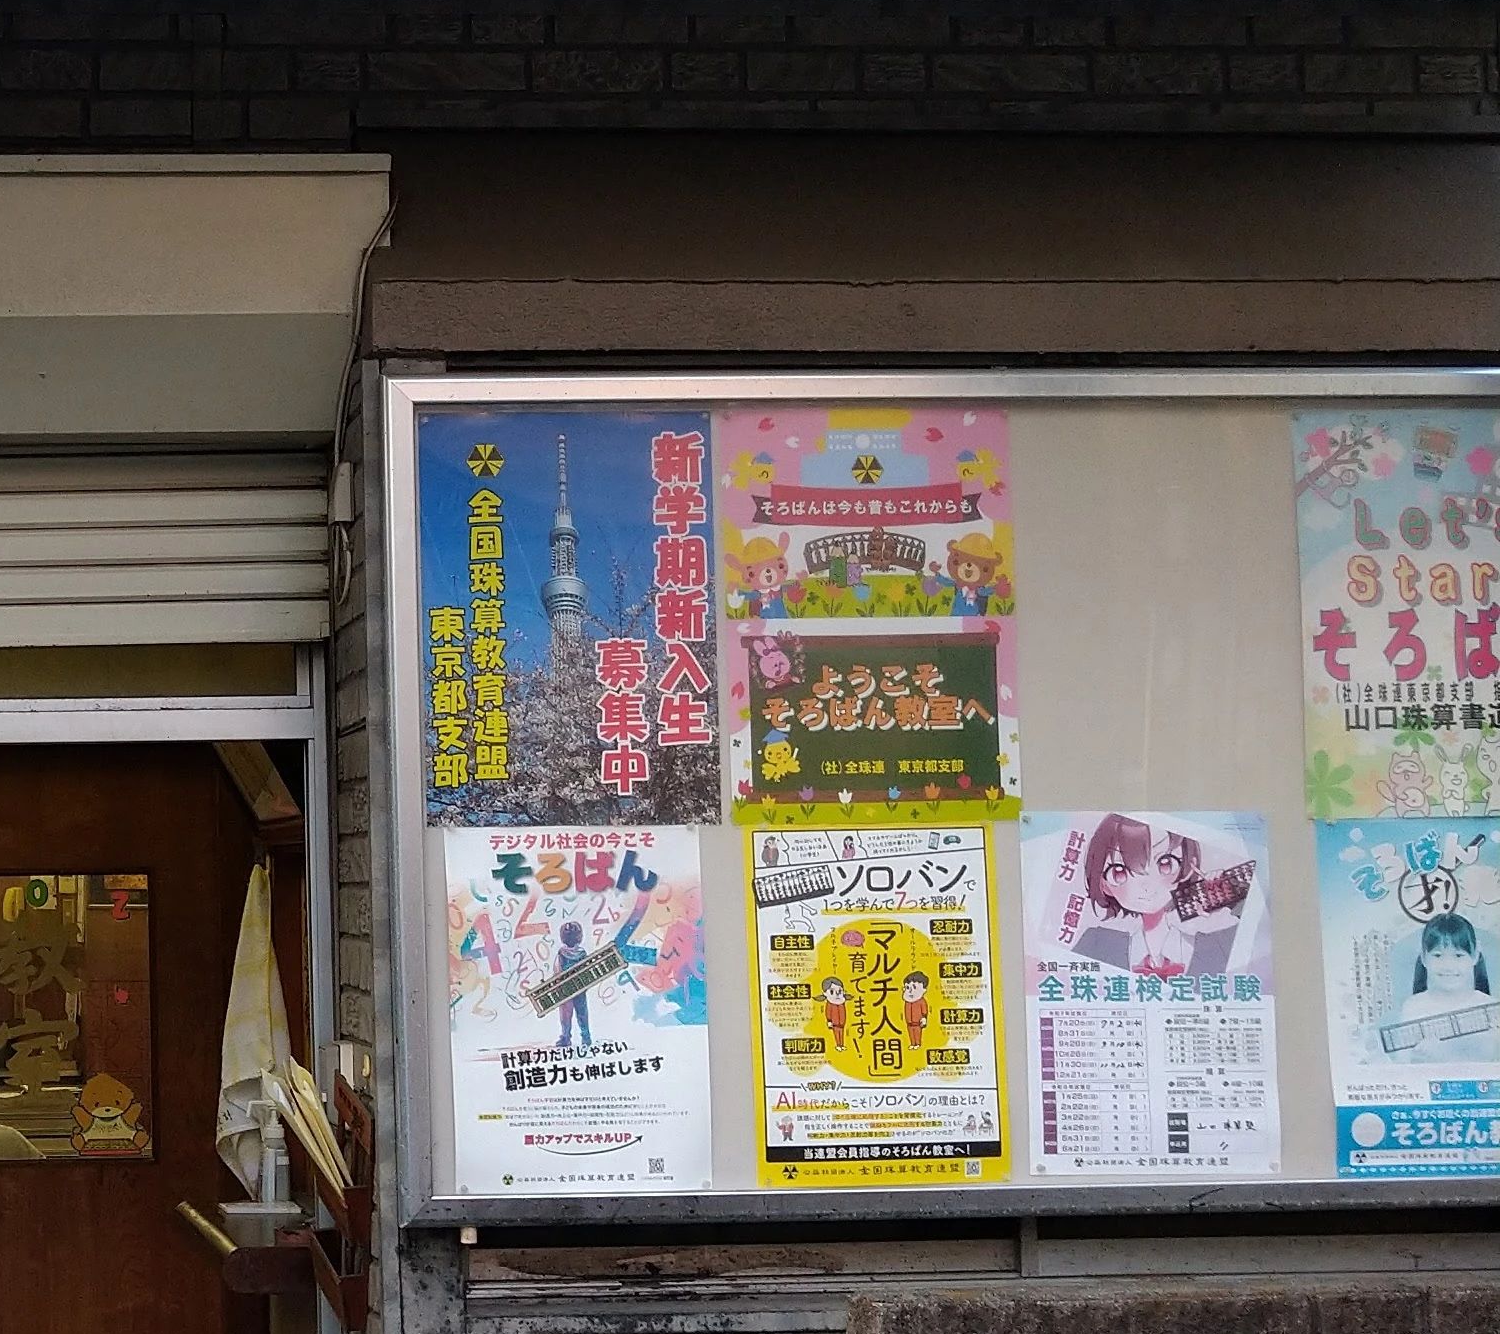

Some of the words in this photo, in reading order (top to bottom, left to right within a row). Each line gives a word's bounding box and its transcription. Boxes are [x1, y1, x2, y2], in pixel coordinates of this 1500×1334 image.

[761, 498, 972, 516] そろばんは今も昔もこれからも
[651, 430, 711, 746] 新学期新入生
[467, 488, 509, 781] 全国珠算教育連盟
[812, 662, 944, 698] ようこそ
[430, 606, 468, 787] 東京都支部
[595, 638, 649, 794] 募集中
[762, 695, 995, 731] そろばん教室へ
[489, 832, 655, 851] デジタル社会の今こそ
[1058, 830, 1086, 882] 計算力
[491, 850, 658, 894] そろばん
[933, 920, 971, 933] 忍耐力
[1058, 893, 1085, 944] 記憶力
[774, 936, 812, 949] 自主性
[942, 963, 979, 977] 集中力
[1037, 961, 1100, 973] 全国一斉実施
[770, 986, 809, 998] 社会性
[1038, 974, 1262, 1002] 全珠連検定試験
[943, 1010, 980, 1024] 計算力
[501, 1041, 628, 1069] 計算力だけじゃない
[784, 1040, 822, 1053] 判断力
[503, 1055, 664, 1092] 創造力も伸ばします
